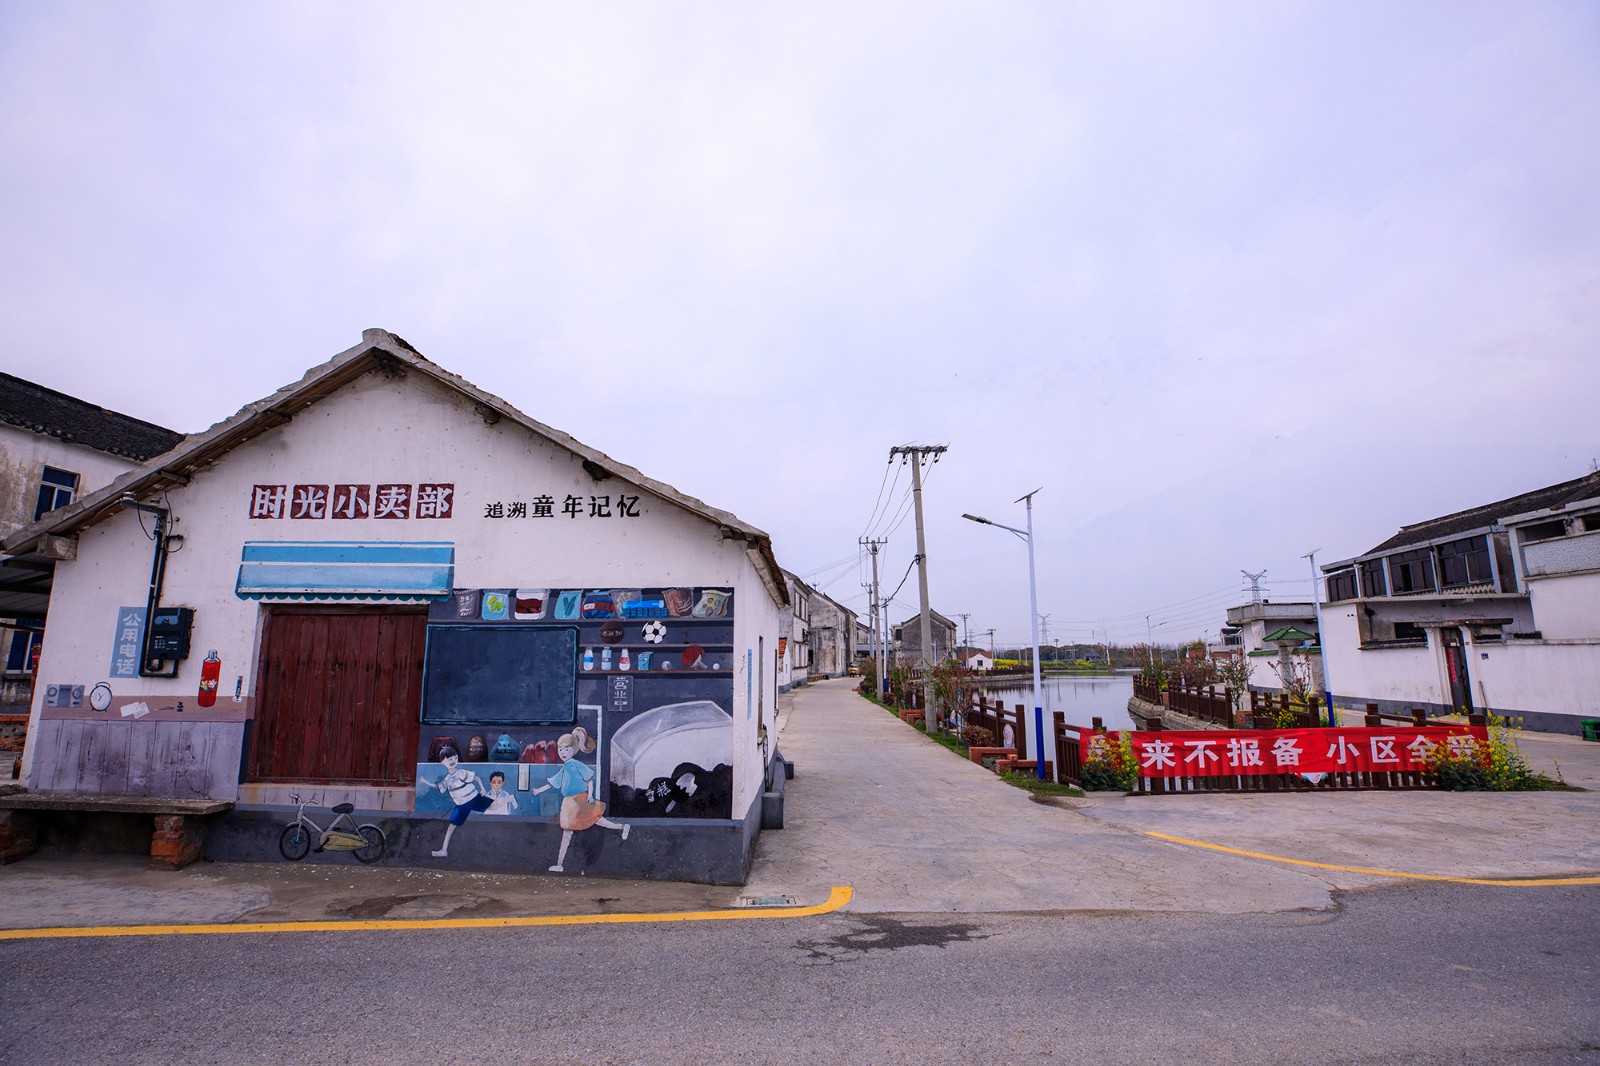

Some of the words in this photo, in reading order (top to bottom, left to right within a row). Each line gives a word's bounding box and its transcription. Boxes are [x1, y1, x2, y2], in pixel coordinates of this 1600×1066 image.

[252, 485, 453, 518] 时光小卖部
[484, 495, 641, 519] 追溯童年记忆
[116, 613, 142, 675] 公用电话
[613, 676, 629, 711] 营业中
